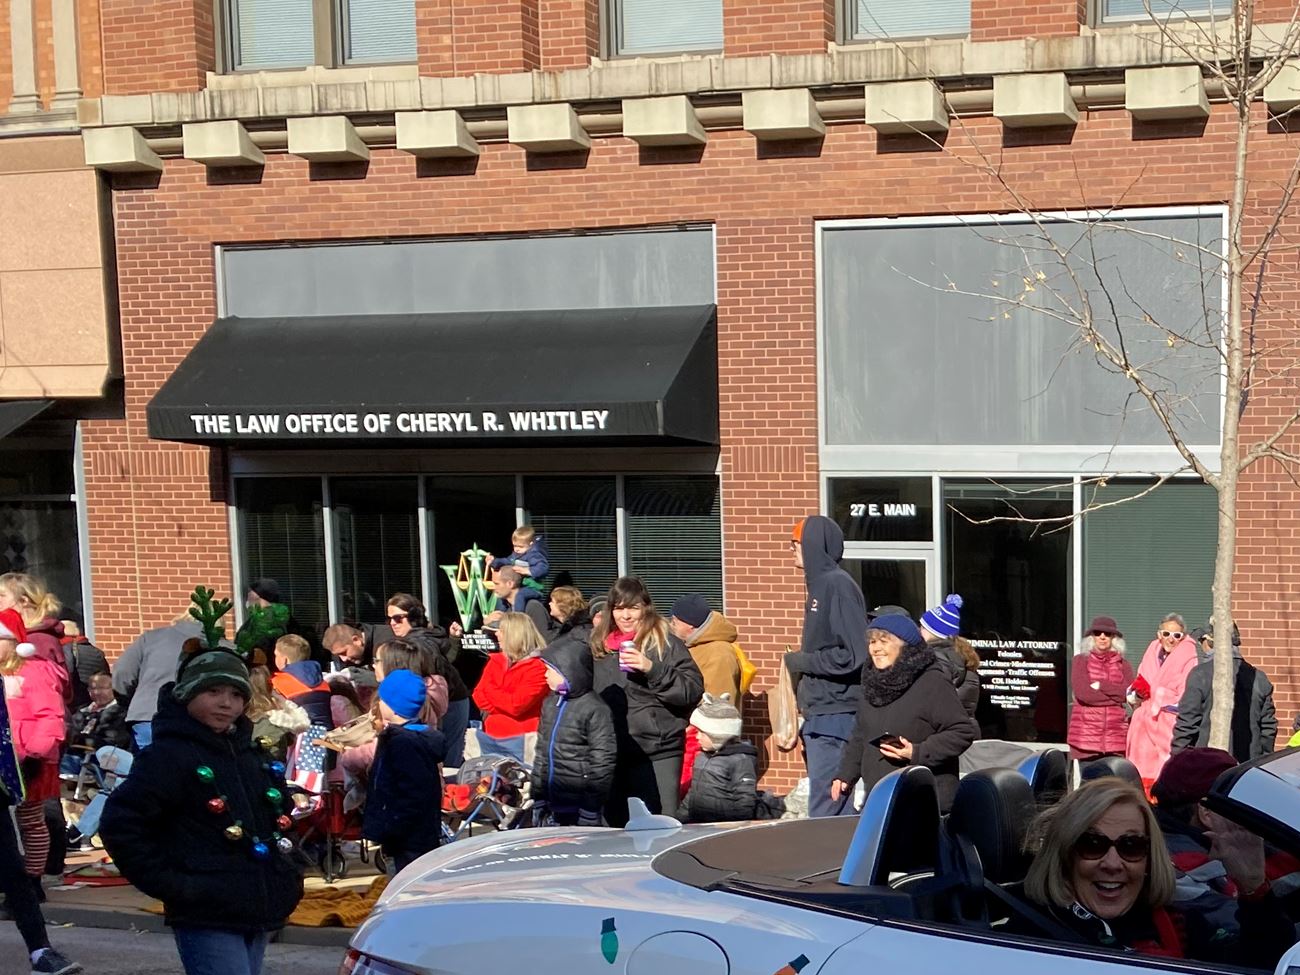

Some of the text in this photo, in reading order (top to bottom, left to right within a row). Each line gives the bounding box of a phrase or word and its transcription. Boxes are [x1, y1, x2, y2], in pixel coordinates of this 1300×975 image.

[190, 410, 609, 433] THE LAW OFFICE OF CHERYL R. WHITLEY
[850, 503, 916, 516] 27 E. MAIN
[966, 640, 1059, 649] IMINAL LAW ATTORNEY
